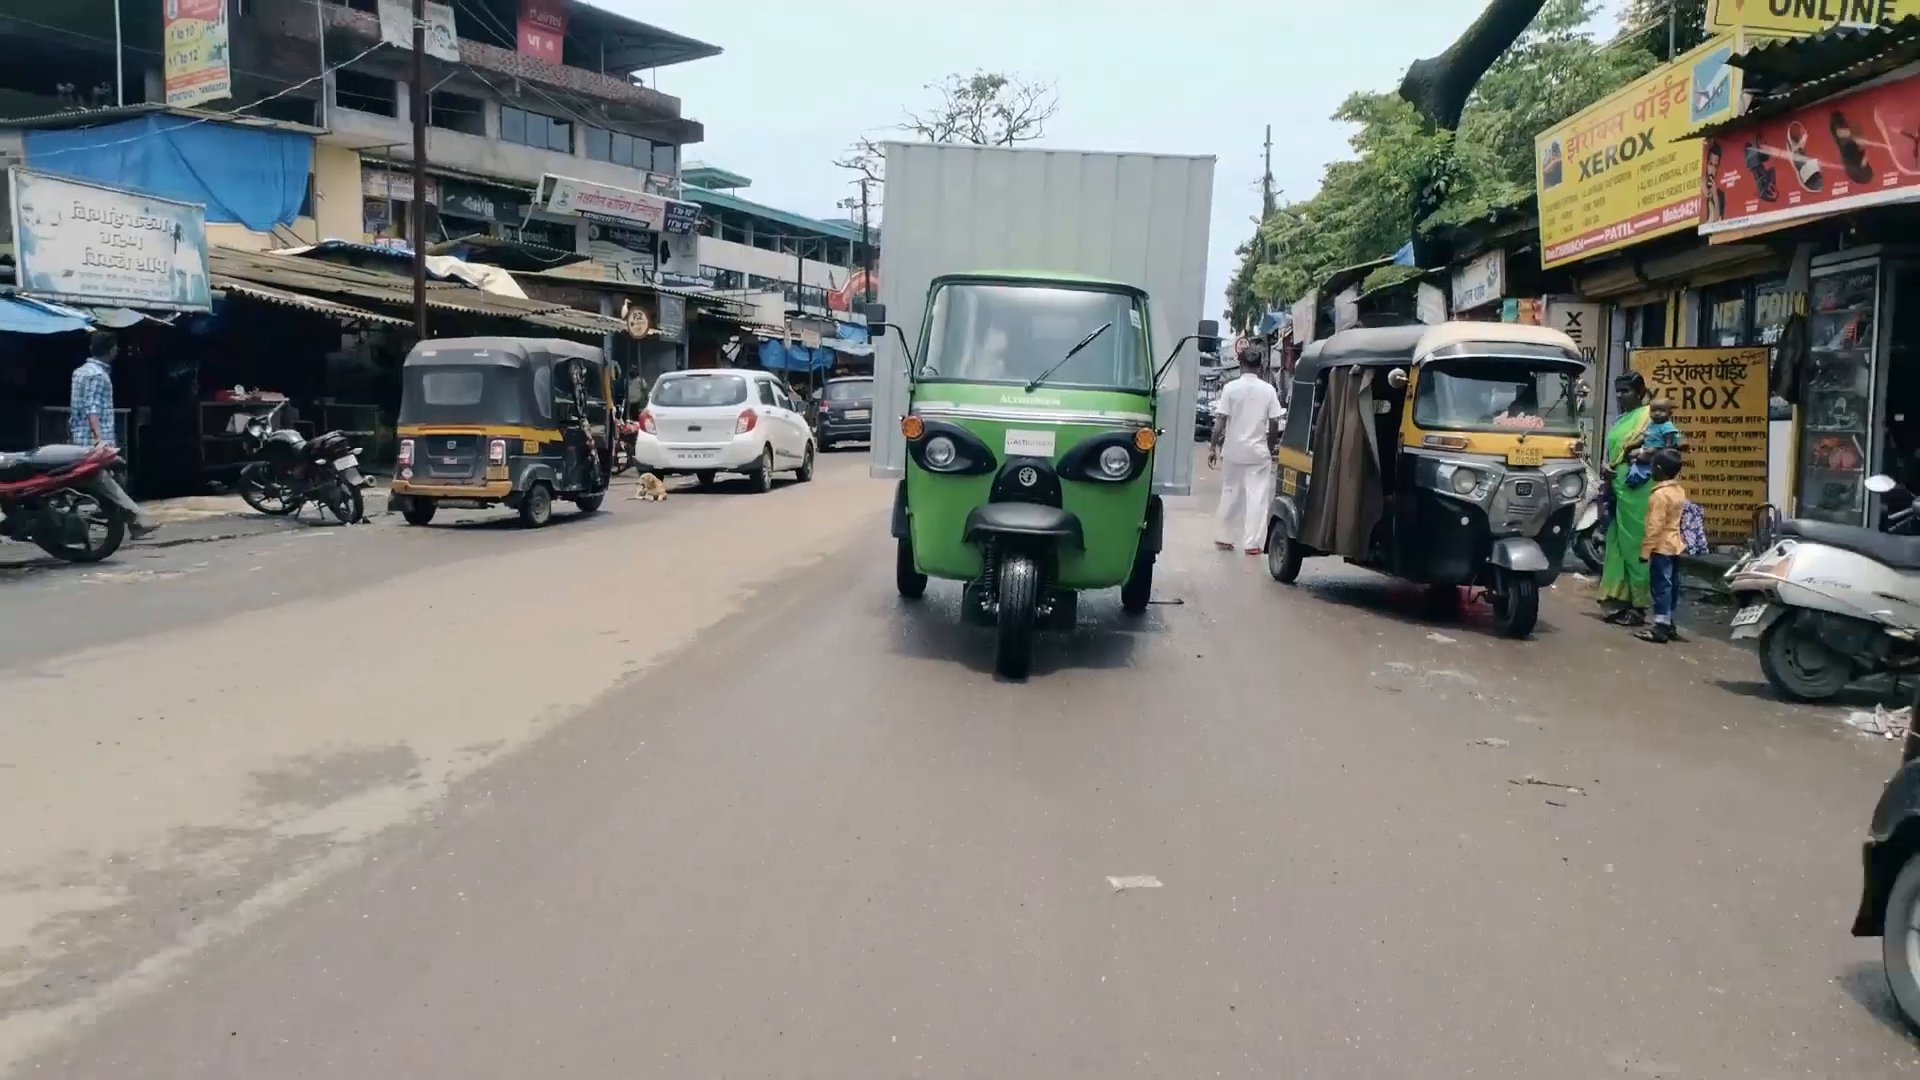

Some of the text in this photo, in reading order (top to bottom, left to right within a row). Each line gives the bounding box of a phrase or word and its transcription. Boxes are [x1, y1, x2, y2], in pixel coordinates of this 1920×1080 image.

[1768, 0, 1897, 24] ONLINE
[1579, 127, 1655, 184] XEROX
[1603, 223, 1635, 241] PATIL
